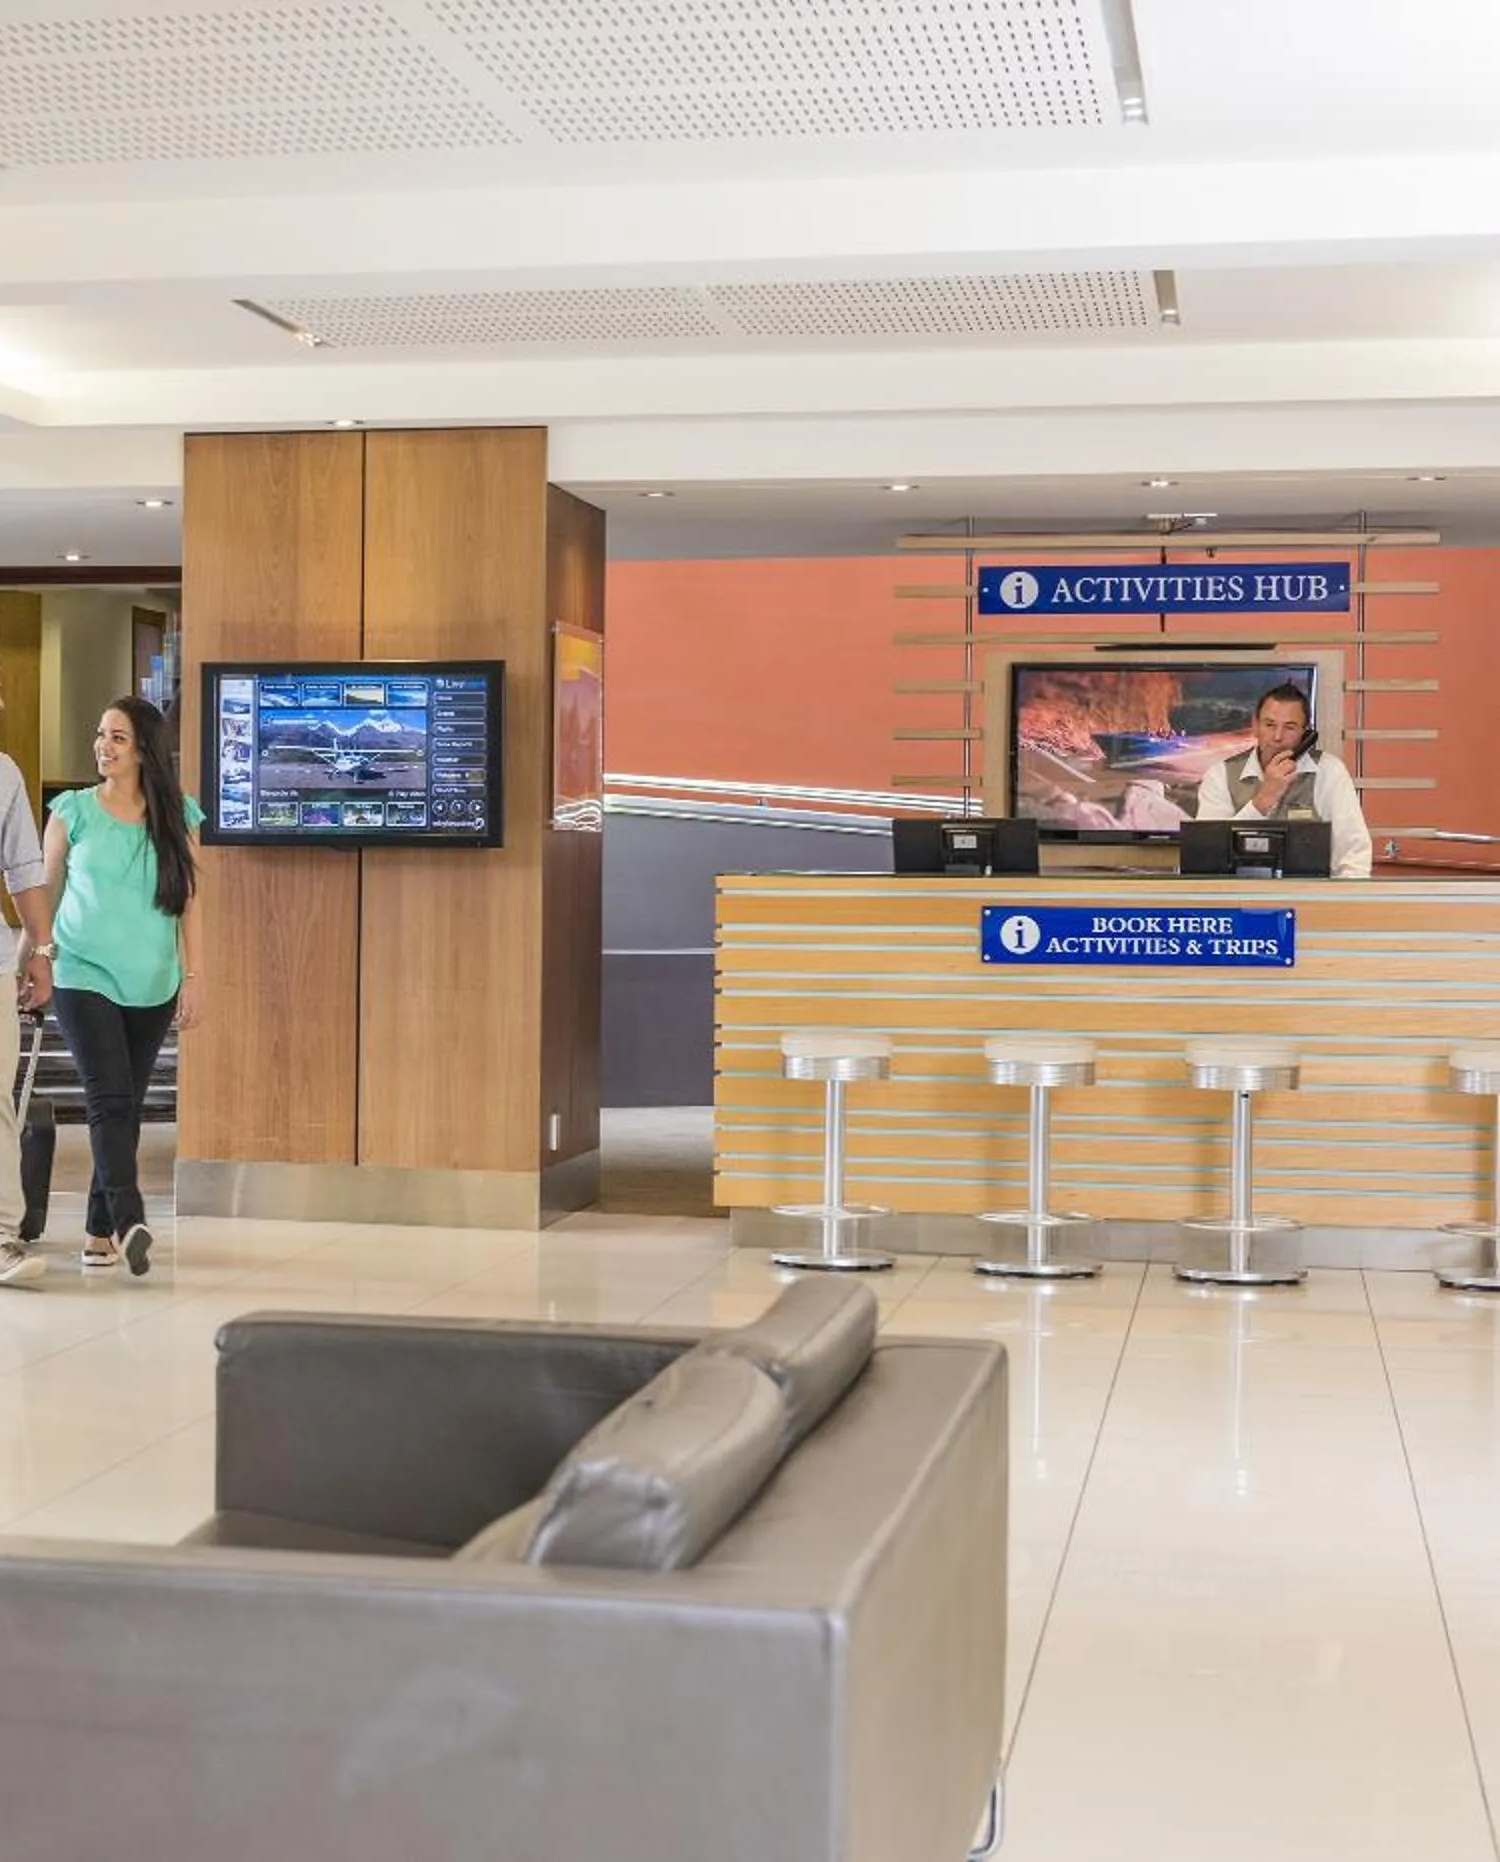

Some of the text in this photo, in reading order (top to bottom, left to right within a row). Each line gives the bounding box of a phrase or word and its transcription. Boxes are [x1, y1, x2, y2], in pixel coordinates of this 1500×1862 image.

[1051, 575, 1245, 603] ACTIVITIES
[1252, 574, 1329, 601] HUB
[1092, 917, 1163, 933] BOOK
[1167, 917, 1233, 934] HERE
[1045, 937, 1279, 955] ACTIVITIES & TRIPS
